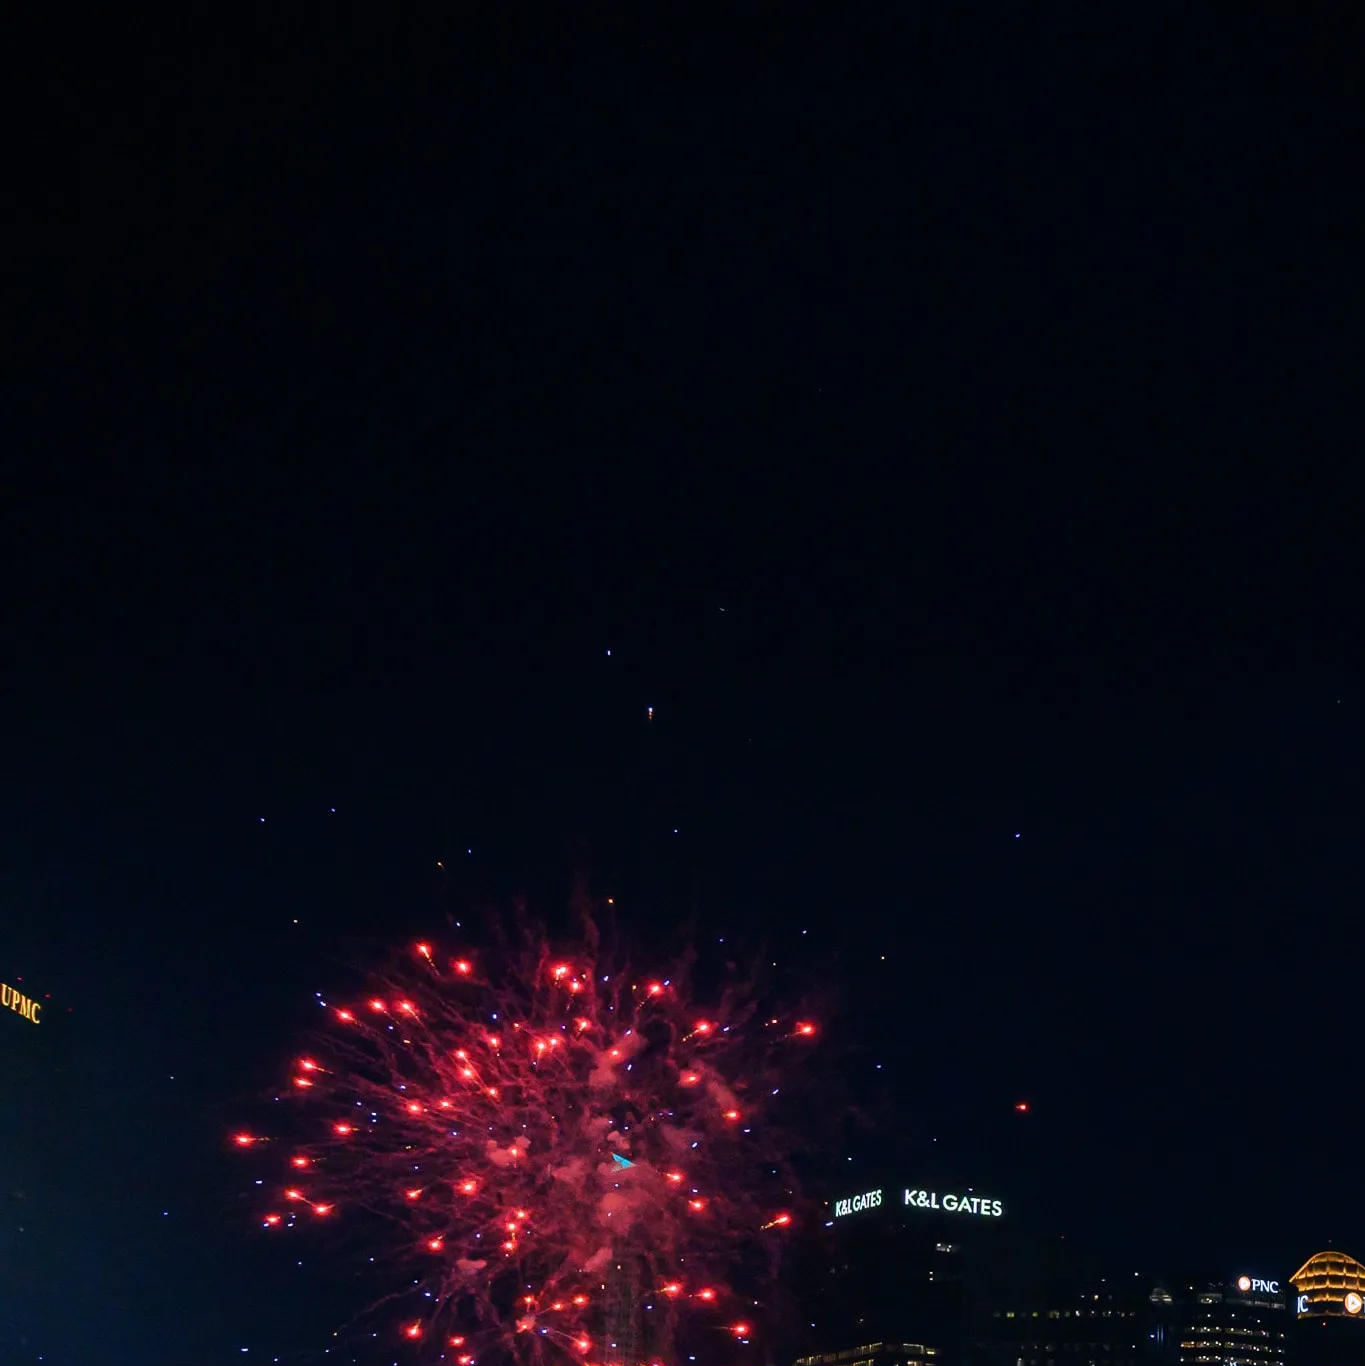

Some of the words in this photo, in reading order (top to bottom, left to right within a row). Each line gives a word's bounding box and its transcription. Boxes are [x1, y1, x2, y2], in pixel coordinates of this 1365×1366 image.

[2, 983, 41, 1024] UPMC
[836, 1198, 852, 1217] K&L
[853, 1190, 882, 1211] GATES
[904, 1189, 940, 1209] K&L
[942, 1195, 1003, 1216] GATES
[1251, 1279, 1279, 1294] PNC
